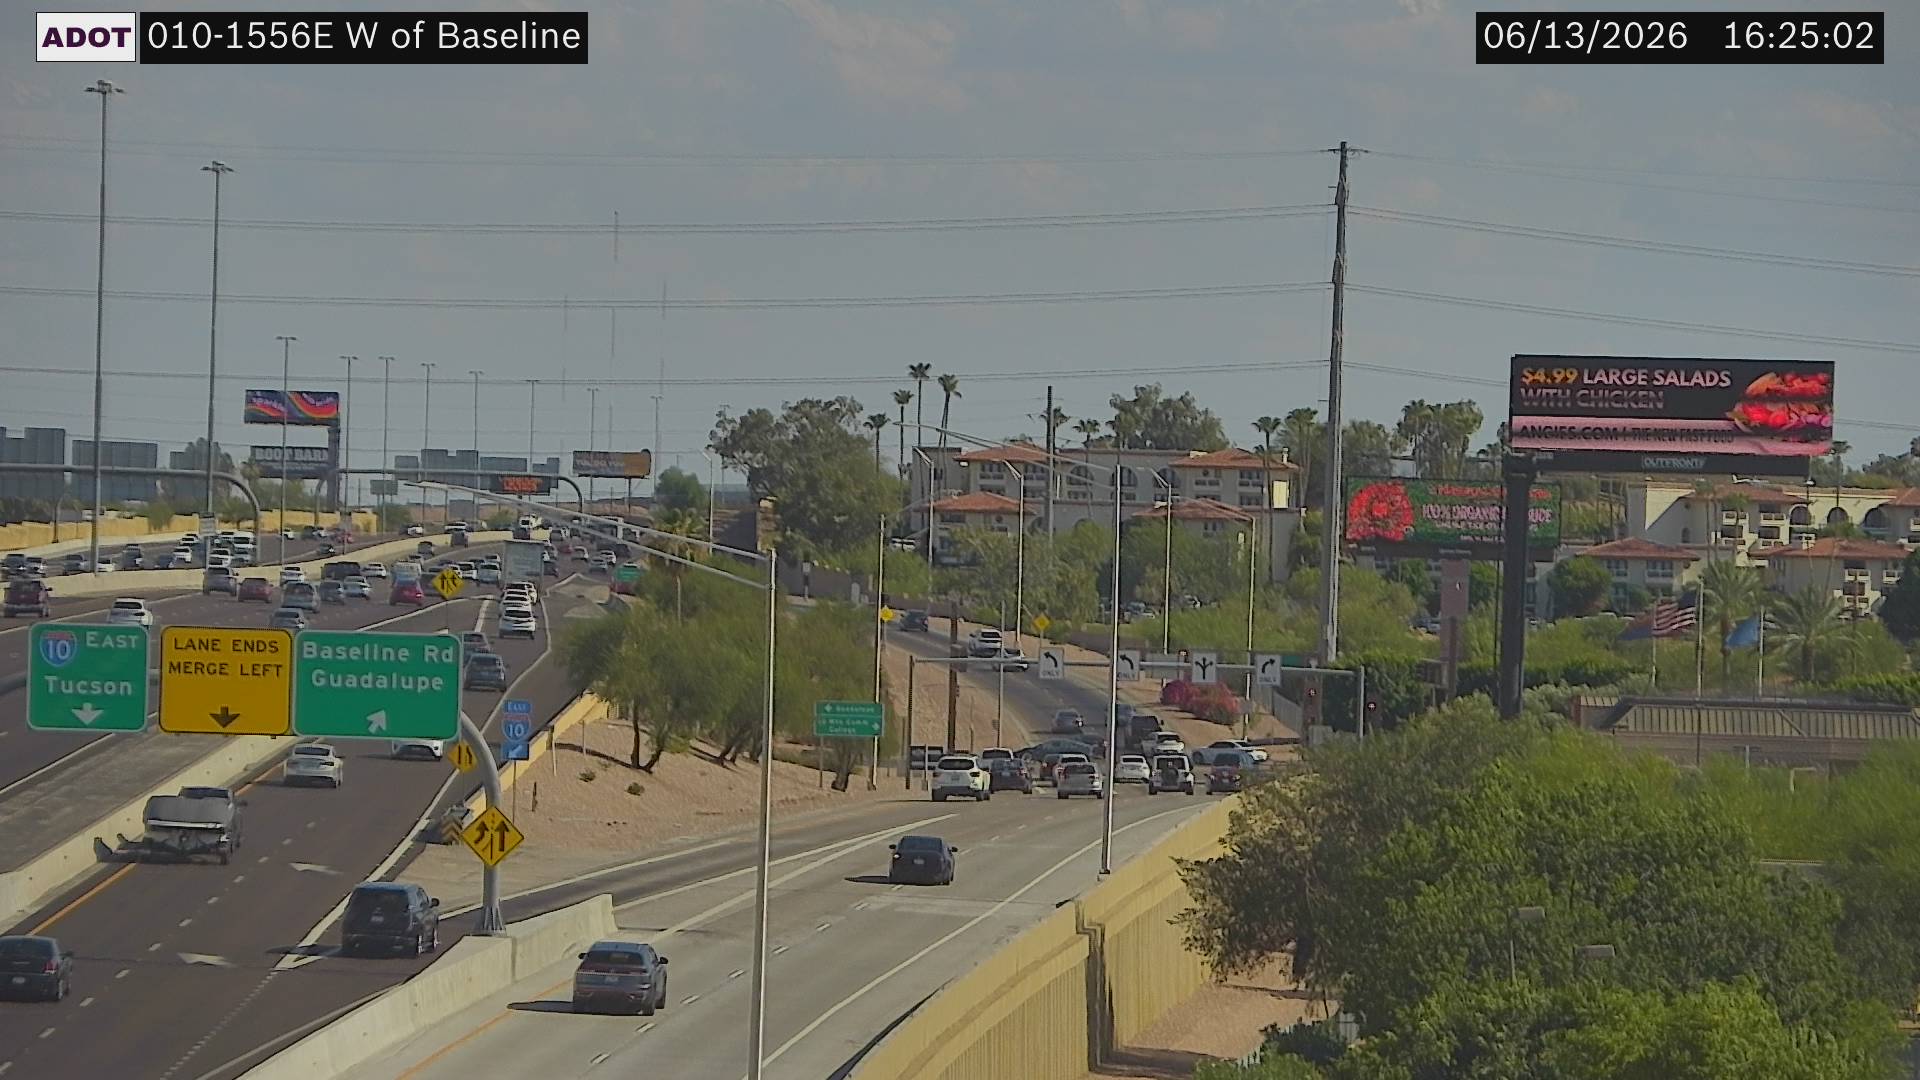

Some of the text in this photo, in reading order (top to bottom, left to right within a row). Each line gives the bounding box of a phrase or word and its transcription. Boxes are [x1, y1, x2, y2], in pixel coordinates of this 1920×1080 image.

[1521, 367, 1731, 388] $4.99 LARGE SALADS
[1521, 387, 1664, 409] WITH CHICKEN
[255, 447, 293, 461] BOOT
[46, 631, 138, 661] 10 EAST
[174, 637, 280, 655] LANE ENDS
[302, 641, 454, 663] Baseline Rd
[167, 661, 284, 678] MERGE LEFT
[44, 676, 133, 696] Tucson
[311, 669, 444, 693] Guadalupe
[509, 723, 525, 738] 10
